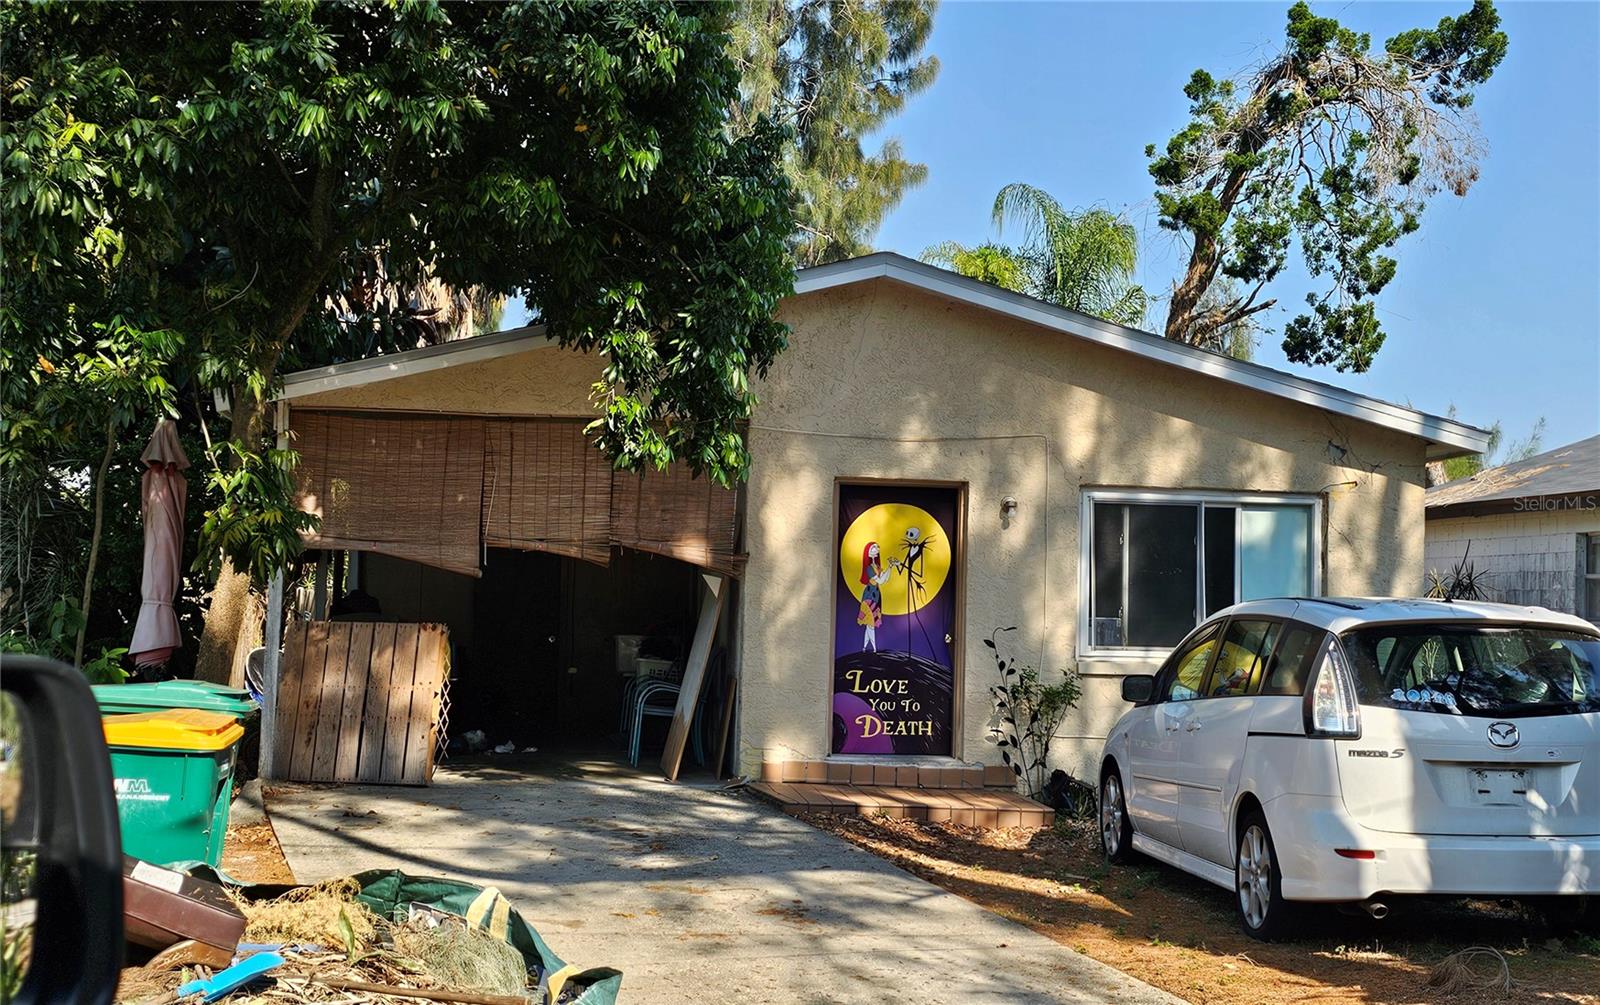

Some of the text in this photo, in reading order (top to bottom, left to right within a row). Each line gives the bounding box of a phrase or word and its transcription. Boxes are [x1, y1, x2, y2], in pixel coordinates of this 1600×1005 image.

[845, 669, 909, 694] LOVE
[869, 698, 921, 712] YOU TO
[855, 714, 933, 738] DEATH
